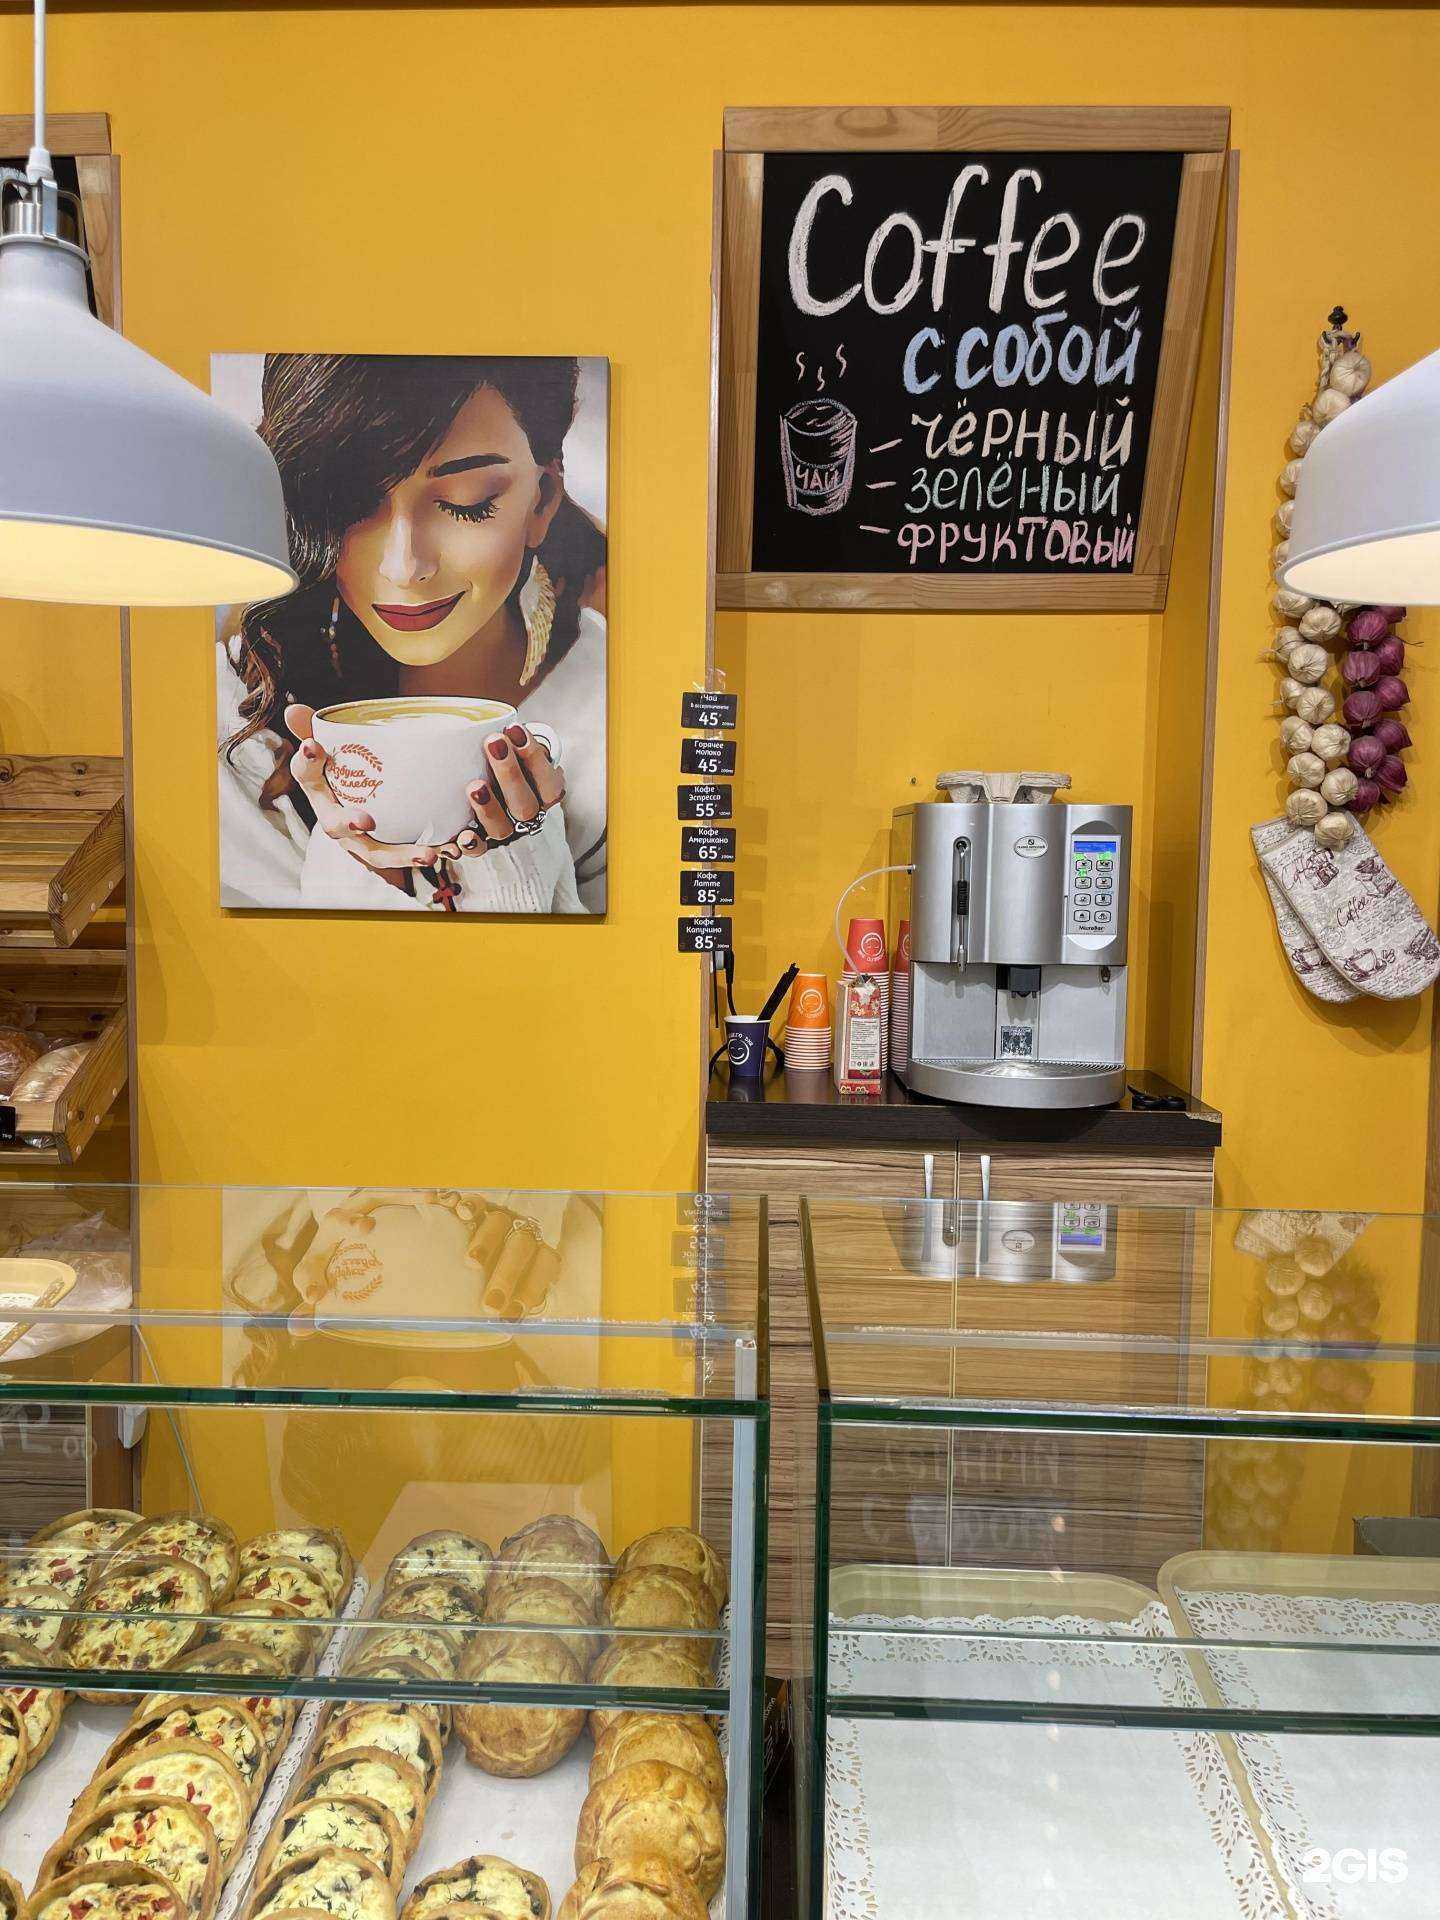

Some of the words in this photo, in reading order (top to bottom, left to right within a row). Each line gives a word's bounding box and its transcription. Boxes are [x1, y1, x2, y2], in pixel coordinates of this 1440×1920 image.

[787, 164, 1147, 317] Coffee
[694, 740, 724, 749] Горячее
[694, 786, 715, 794] Кофе
[688, 794, 721, 802] Эспрессо
[698, 828, 719, 837] Кофе
[688, 836, 729, 844] Американо
[696, 872, 718, 880] Кофе
[693, 918, 715, 927] Кофе
[686, 926, 722, 935] Капучино
